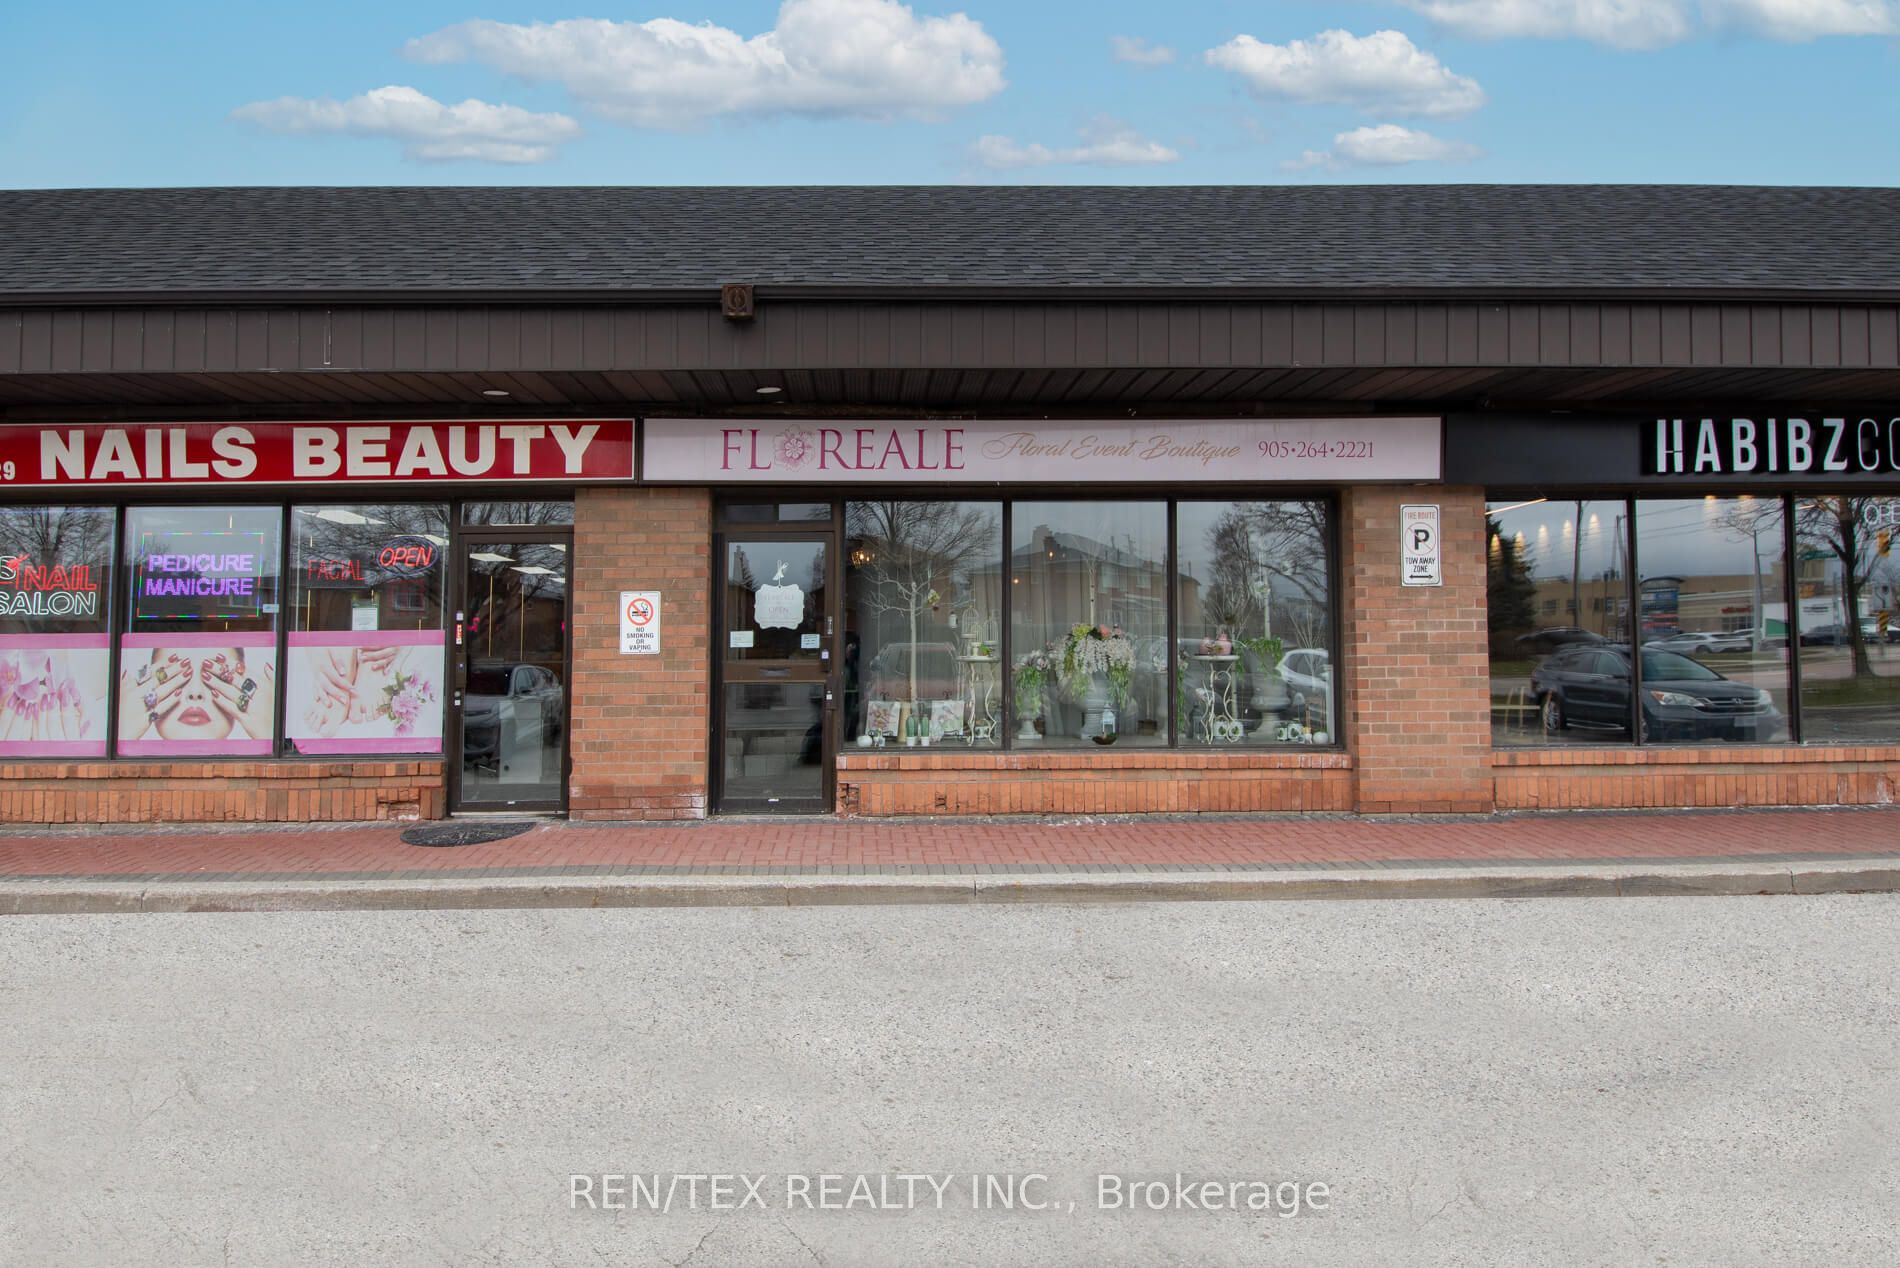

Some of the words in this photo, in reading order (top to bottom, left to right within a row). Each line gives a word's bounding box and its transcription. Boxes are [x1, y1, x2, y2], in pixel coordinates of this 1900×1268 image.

[40, 426, 258, 480] NAILS
[293, 425, 602, 477] BEAUTY
[981, 433, 1072, 460] Floral
[1071, 435, 1142, 460] Event
[1139, 435, 1241, 466] Boutique
[148, 554, 254, 572] PEDICURE
[379, 546, 433, 567] OPEN
[1405, 557, 1419, 565] TOW
[1419, 557, 1436, 565] AWAY
[23, 564, 97, 590] NAIL
[307, 559, 366, 580] FACIAL
[1413, 565, 1428, 573] ZONE
[145, 577, 254, 596] MANICURE
[0, 591, 96, 615] SALON
